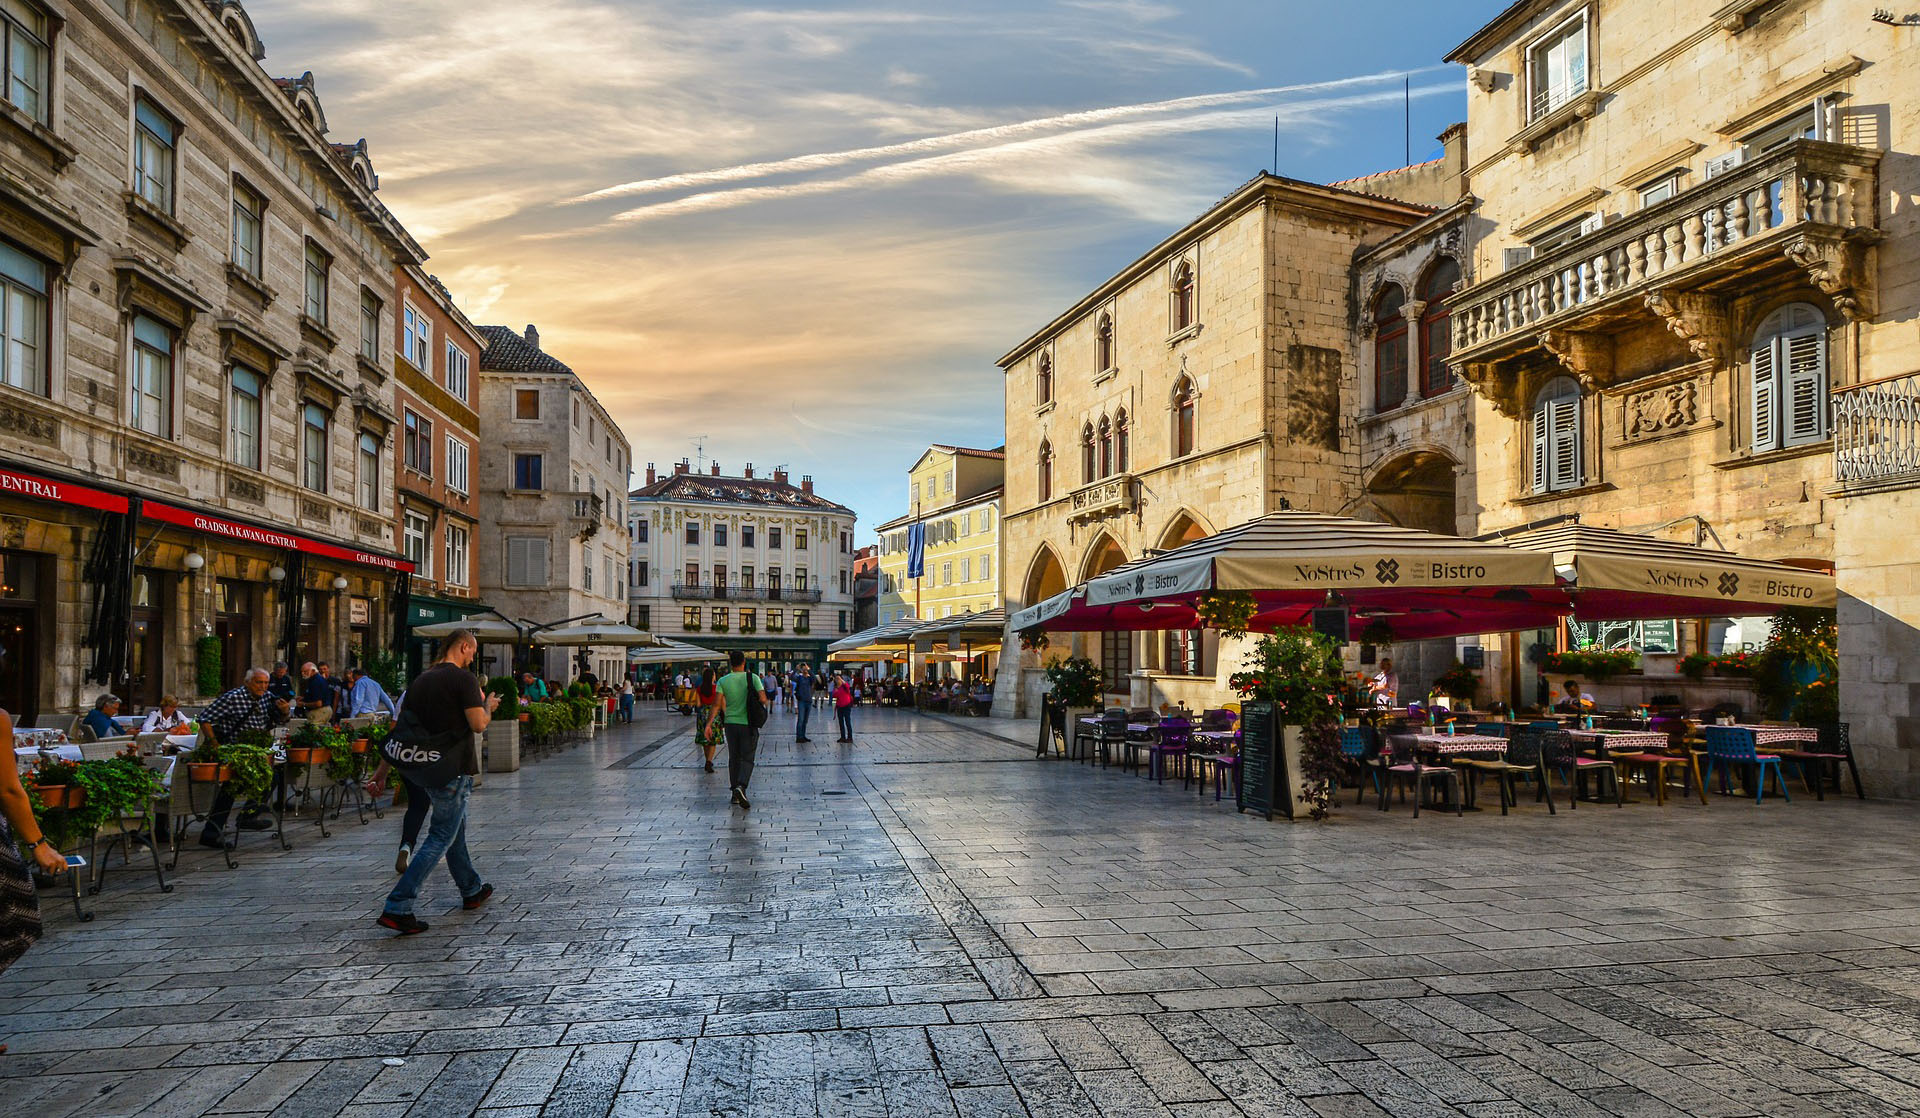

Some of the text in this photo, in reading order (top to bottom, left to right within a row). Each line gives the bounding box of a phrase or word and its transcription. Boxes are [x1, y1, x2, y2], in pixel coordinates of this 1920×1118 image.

[0, 474, 61, 499] ENTRAL
[194, 517, 298, 548] GRADSKA KAVANA CENTRAL
[370, 556, 377, 564] DE
[377, 557, 384, 566] LA
[384, 558, 397, 569] VILLE
[1431, 562, 1486, 579] Bistro
[1155, 574, 1179, 589] Bistro
[1766, 580, 1813, 599] Bistro
